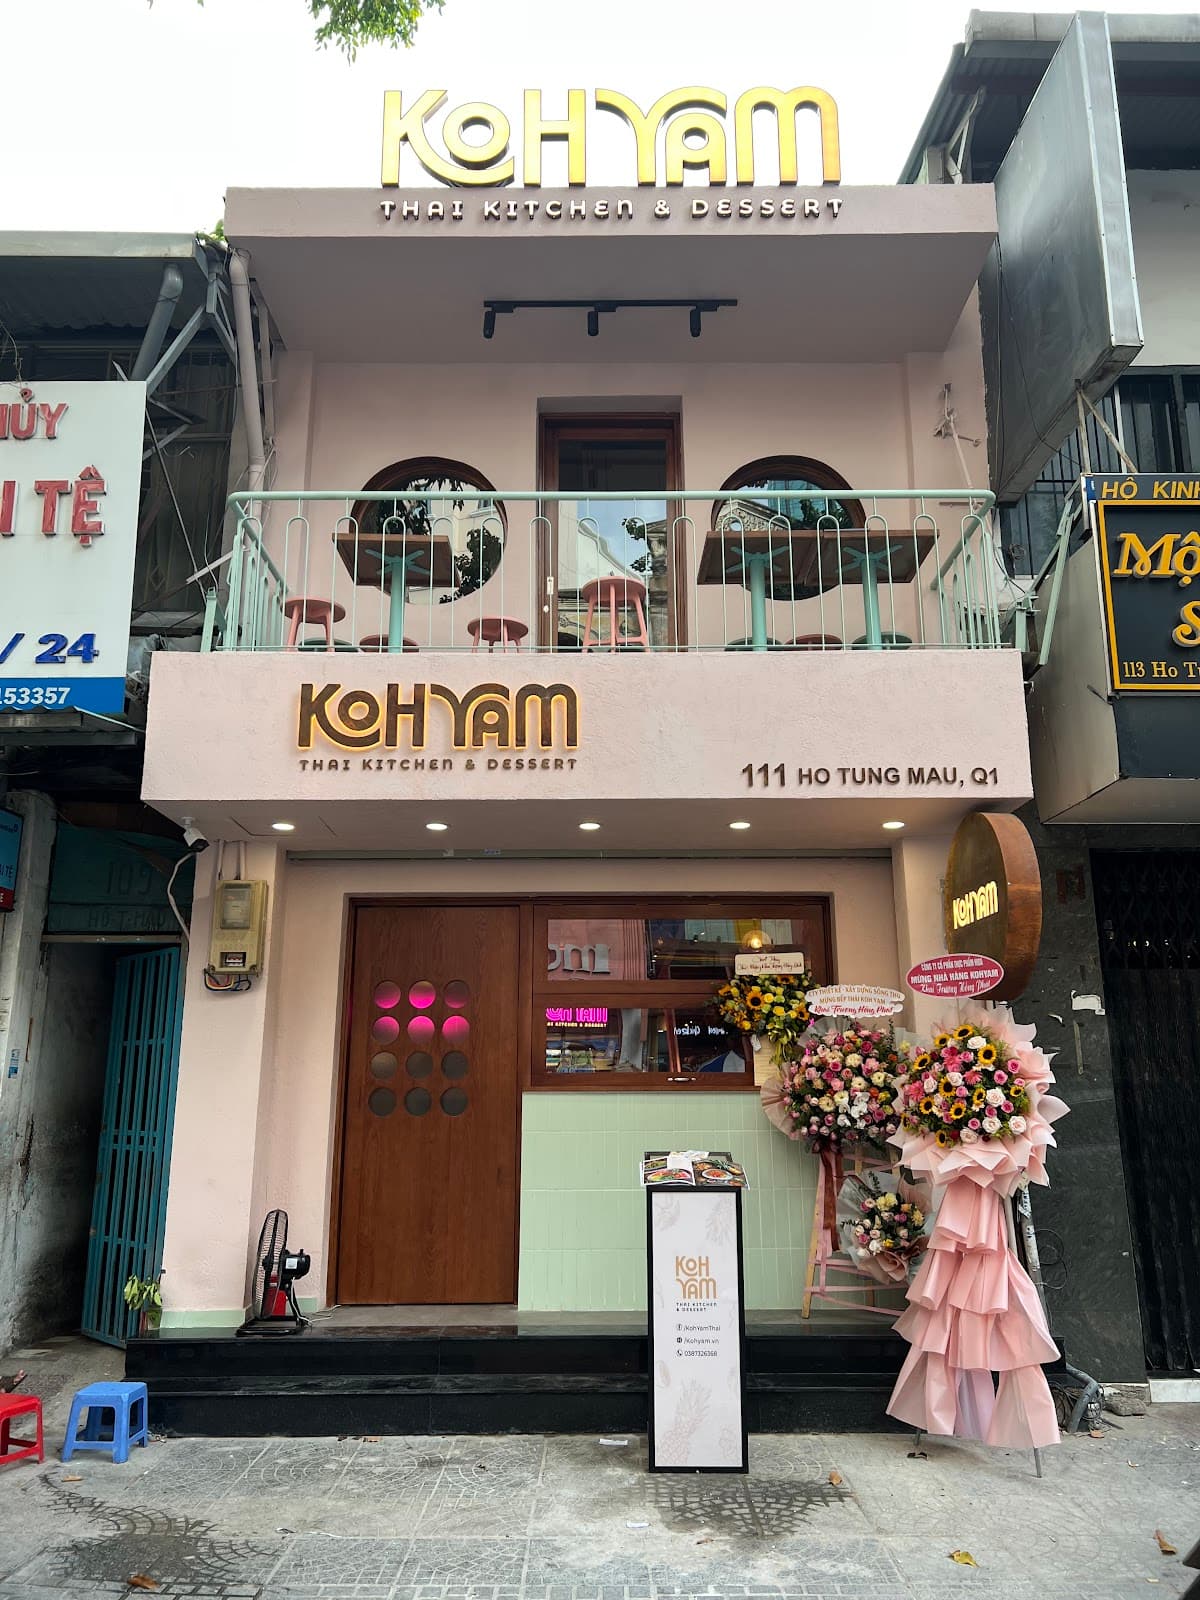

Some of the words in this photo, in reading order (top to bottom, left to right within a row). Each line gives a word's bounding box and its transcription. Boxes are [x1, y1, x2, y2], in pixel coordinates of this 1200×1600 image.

[380, 200, 464, 220] THAI
[484, 199, 634, 220] KITCHEN
[654, 199, 672, 219] &
[692, 199, 843, 219] DESSERT
[34, 464, 107, 547] TỆ
[35, 633, 100, 663] 24
[1123, 661, 1146, 678] 113
[1151, 661, 1178, 678] Ho
[1184, 661, 1200, 678] T
[299, 759, 351, 771] THAI
[362, 759, 454, 771] KITCHEN
[465, 758, 476, 771] &
[487, 758, 578, 771] DESSERT
[742, 763, 786, 788] 111
[798, 767, 831, 786] HO
[837, 767, 901, 786] TUNG
[908, 767, 965, 788] MAU,
[971, 767, 999, 786] Q1
[675, 1256, 710, 1277] KOH
[675, 1278, 717, 1300] YAM
